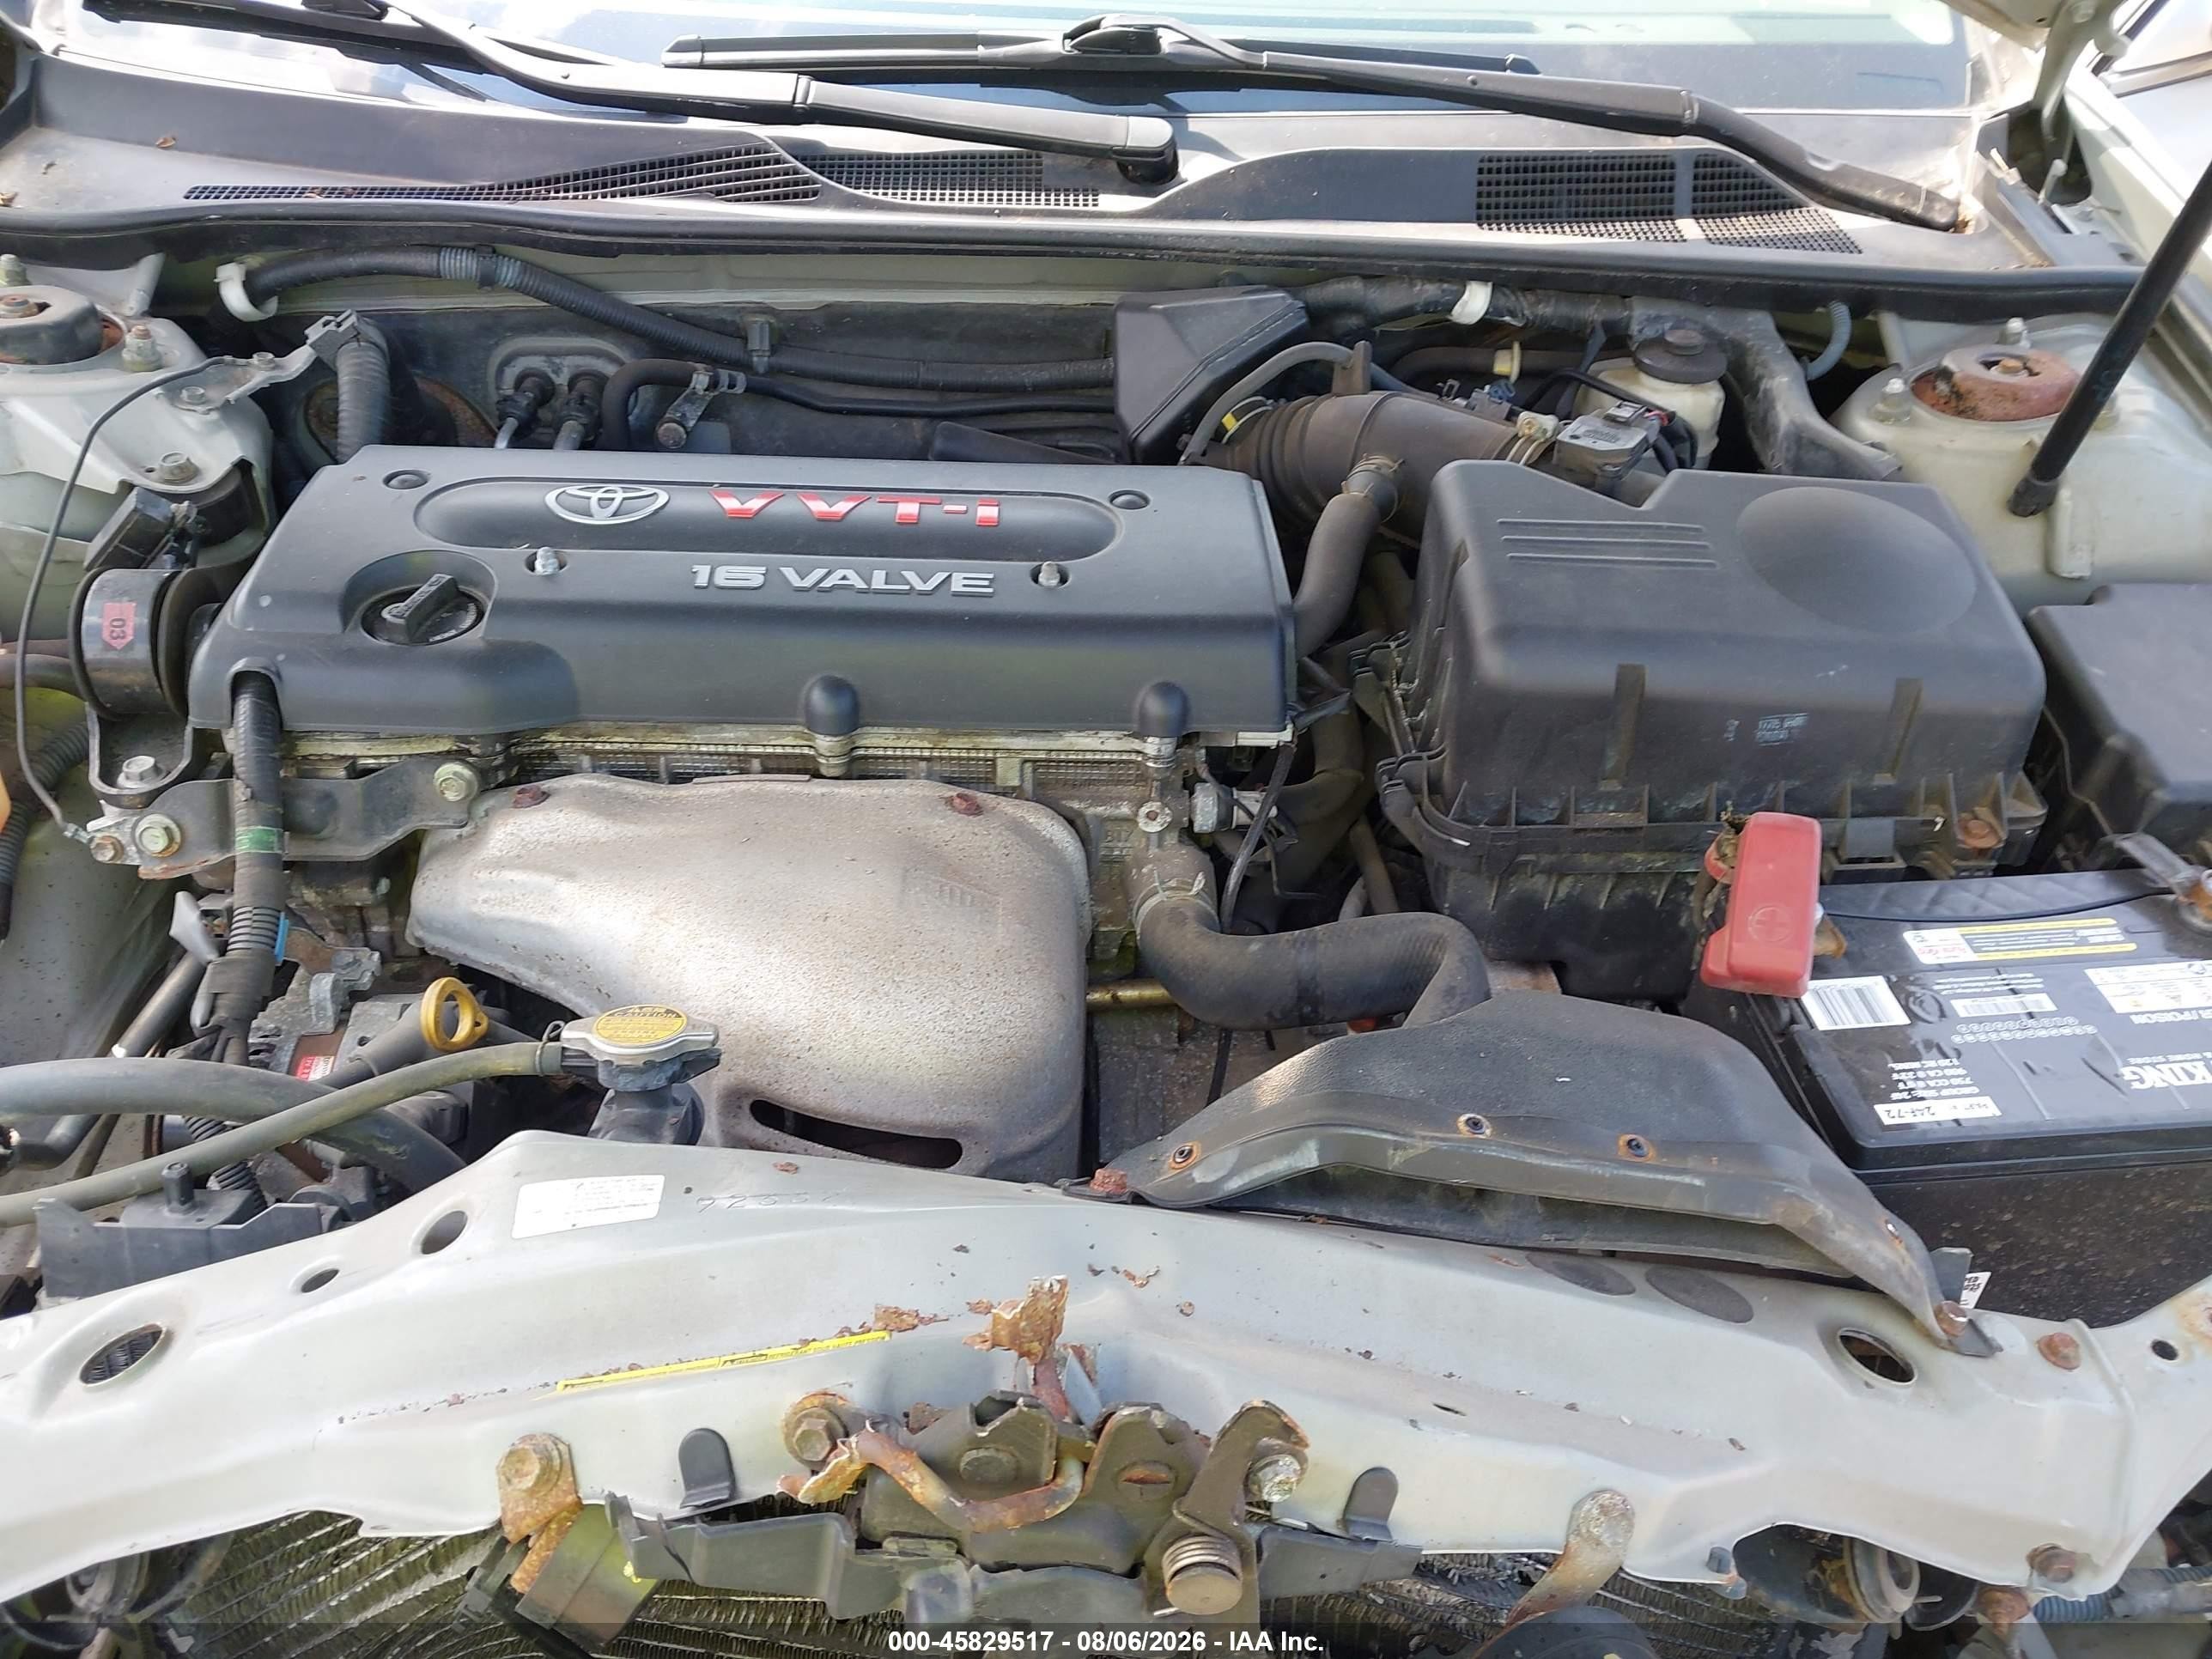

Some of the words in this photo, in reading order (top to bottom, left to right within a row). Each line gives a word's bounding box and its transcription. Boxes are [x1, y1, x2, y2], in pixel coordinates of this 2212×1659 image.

[691, 563, 769, 591] 16
[779, 567, 996, 597] VALVE
[2120, 1060, 2212, 1089] KING
